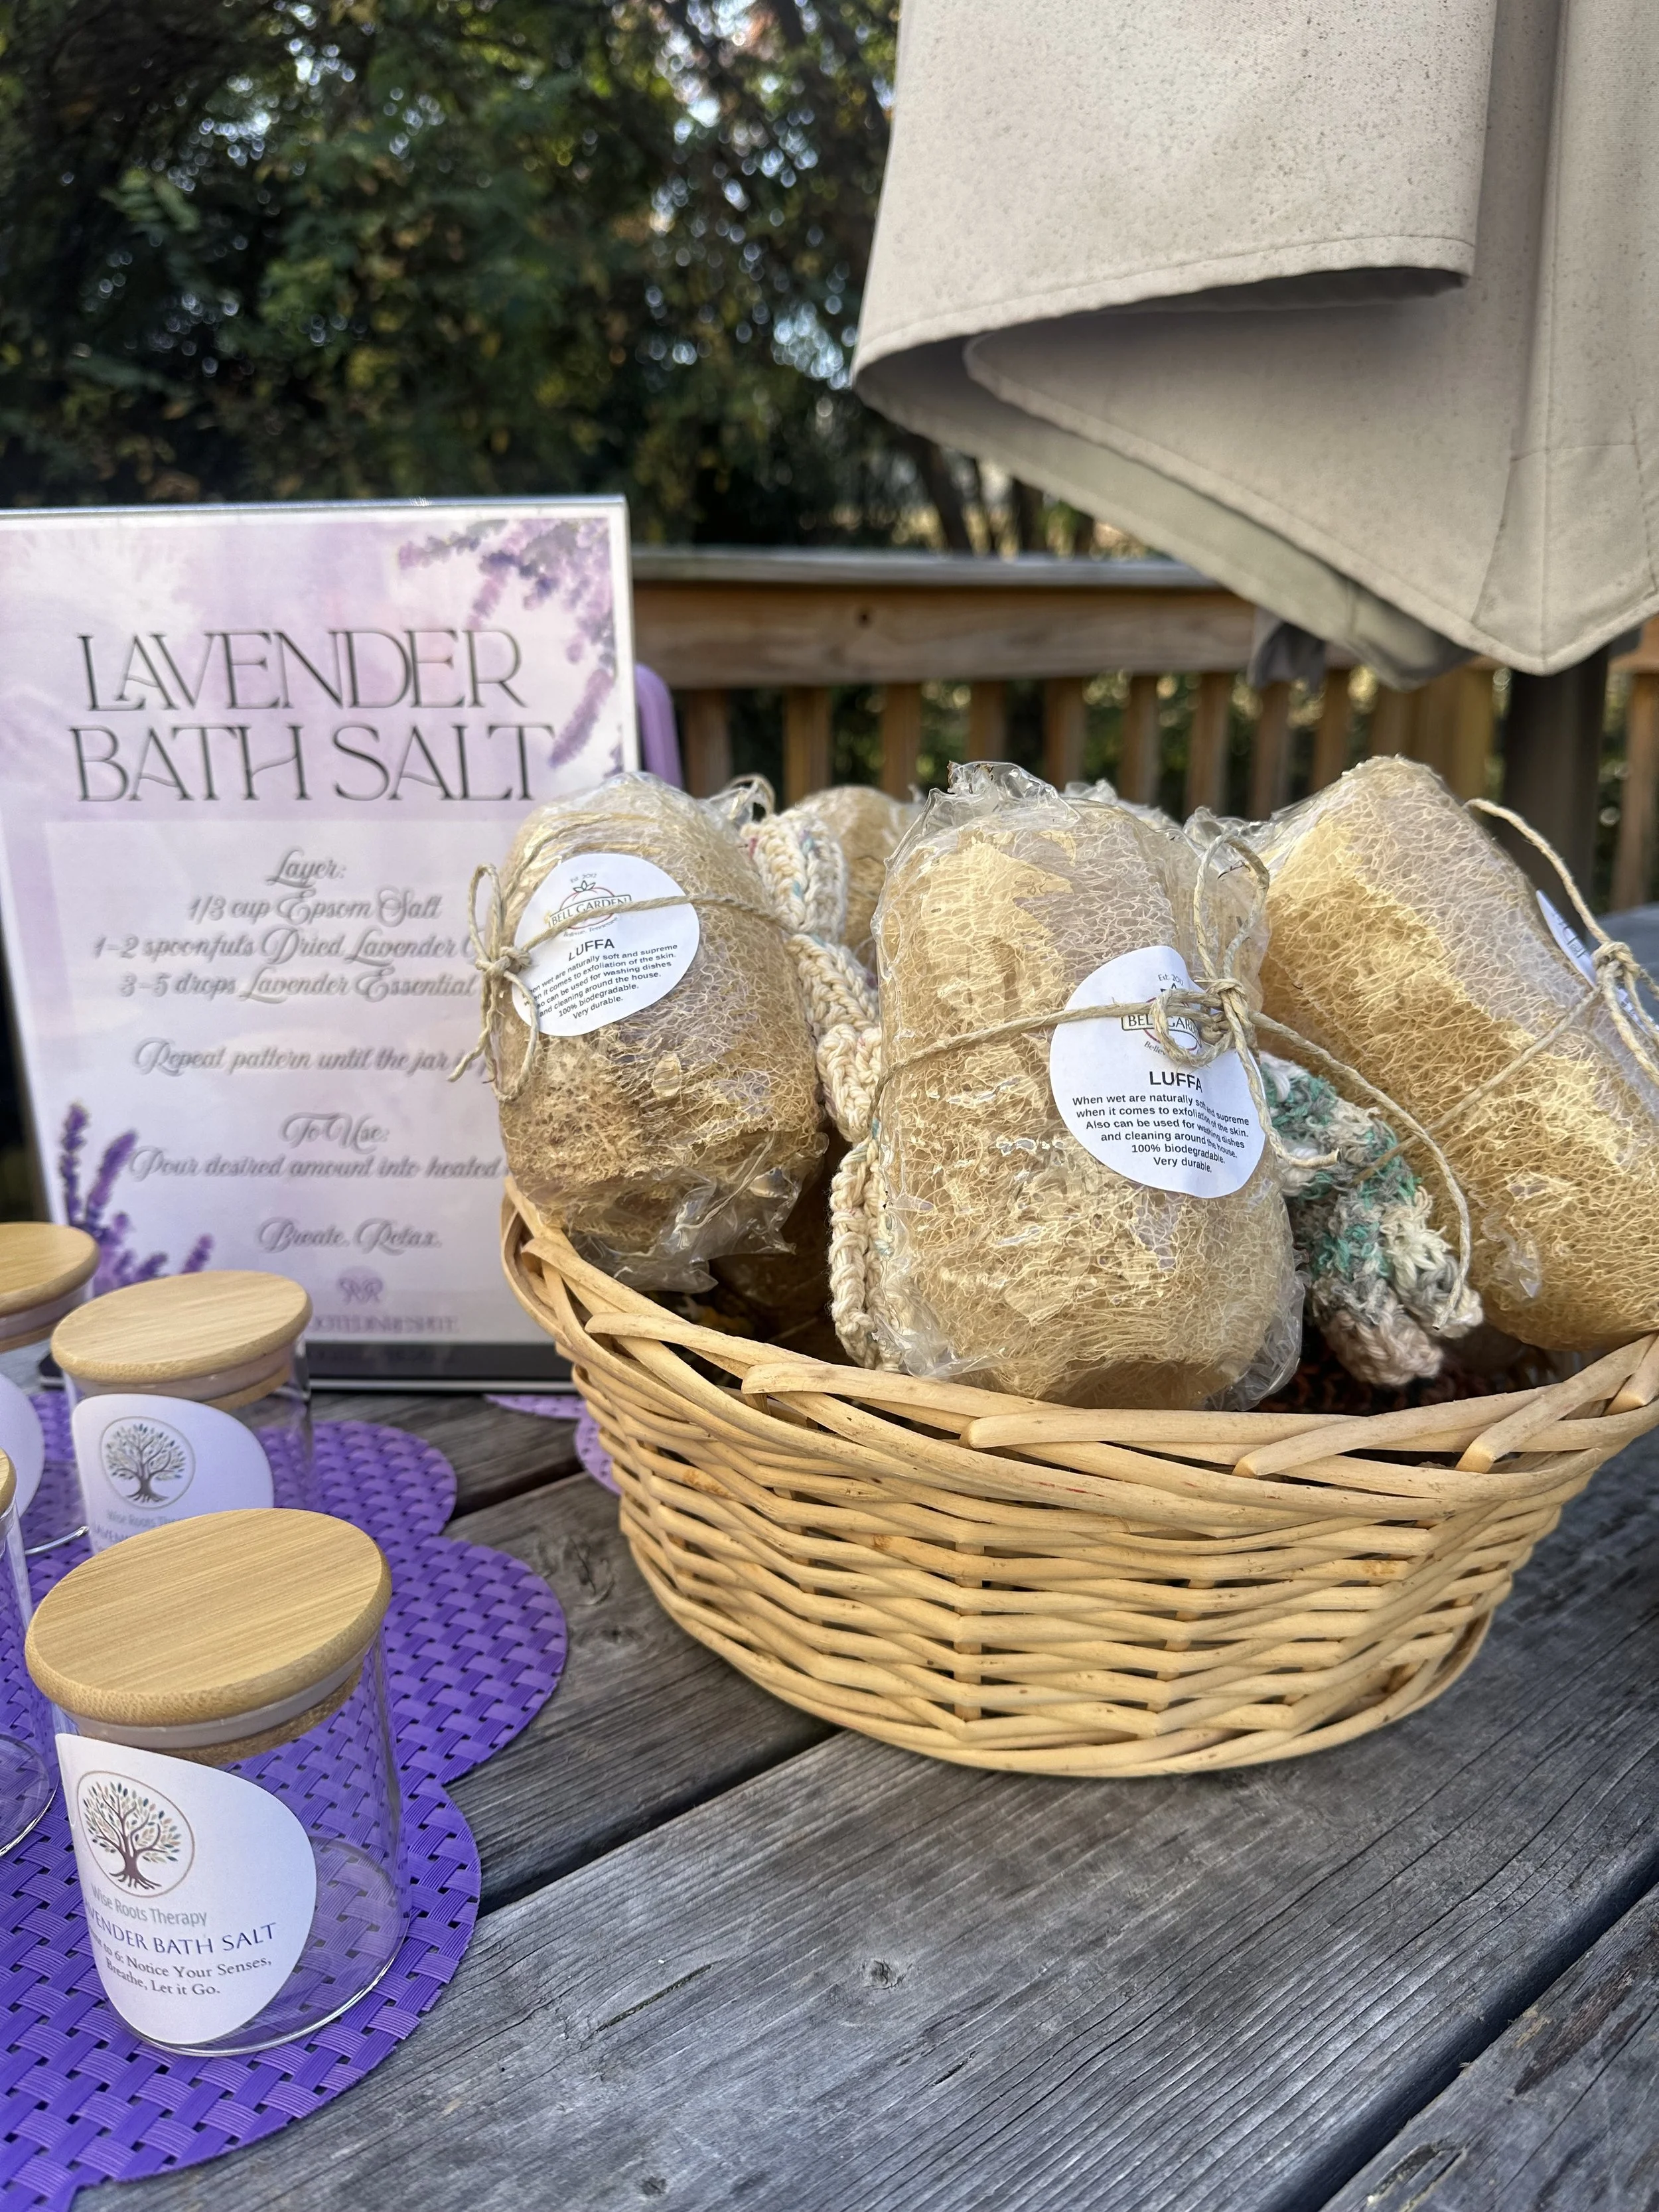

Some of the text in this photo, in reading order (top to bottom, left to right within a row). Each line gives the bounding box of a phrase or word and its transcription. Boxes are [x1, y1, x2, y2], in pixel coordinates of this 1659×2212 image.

[76, 627, 529, 711] LAVENDER
[66, 721, 555, 802] BATH SALT
[264, 846, 346, 889] Layer:
[188, 884, 443, 928] 1/3 cup Epsom Salt
[551, 897, 627, 925] BELL GARDEN
[142, 932, 254, 963] spoonfuls
[261, 923, 346, 964] Dried
[343, 924, 458, 966] Lavender
[569, 938, 615, 961] LUFFA
[542, 976, 554, 987] wet
[555, 970, 566, 980] are
[567, 955, 600, 973] naturally
[640, 944, 678, 956] supreme
[549, 977, 572, 992] comes
[583, 960, 626, 975] exfoliation
[174, 970, 236, 1001] drops
[237, 965, 348, 1004] Lavender
[352, 966, 479, 1003] Essential
[540, 1005, 552, 1017] and
[554, 990, 583, 1009] cleaning
[585, 978, 613, 994] around
[632, 972, 661, 981] house.
[547, 994, 559, 1003] can
[571, 979, 589, 991] used
[590, 973, 601, 982] for
[603, 966, 640, 977] washing
[642, 962, 672, 971] dishes
[559, 984, 639, 1017] 100% biodegradable.
[573, 996, 623, 1019] Very durable.
[1127, 1014, 1153, 1027] BEL
[132, 1037, 227, 1076] Repeat
[224, 1045, 311, 1075] pattern
[317, 1047, 374, 1070] until
[374, 1047, 409, 1070] the
[404, 1049, 449, 1078] jar
[1149, 1070, 1203, 1093] LUFFA
[1072, 1096, 1103, 1106] When
[1149, 1094, 1193, 1106] naturally
[1216, 1112, 1250, 1126] supreme
[1076, 1108, 1105, 1118] when
[1109, 1107, 1116, 1116] it
[1119, 1107, 1155, 1116] comes
[1173, 1107, 1211, 1125] exfoliation
[1217, 1123, 1228, 1133] the
[1230, 1127, 1249, 1138] skin.
[278, 1112, 330, 1148] To
[1086, 1120, 1110, 1129] Also
[1153, 1119, 1179, 1128] used
[1182, 1119, 1194, 1130] for
[1222, 1135, 1245, 1149] dishes
[1101, 1131, 1237, 1158] and cleaning around the house.
[129, 1145, 200, 1182] Pour
[204, 1153, 286, 1177] desired
[287, 1155, 375, 1178] amount
[376, 1155, 421, 1178] into
[425, 1155, 503, 1179] heated
[1131, 1143, 1226, 1163] 100% biodegradable.
[1153, 1157, 1212, 1173] Very durable.
[92, 1883, 207, 1927] Wise Roots Therapy
[153, 1937, 213, 1954] BATH
[222, 1922, 276, 1951] SALT
[106, 1956, 221, 1995] Breathe, Let it Go.
[126, 1954, 169, 1976] Notice
[173, 1966, 212, 1978] Your
[216, 1957, 271, 1976] Senses,
